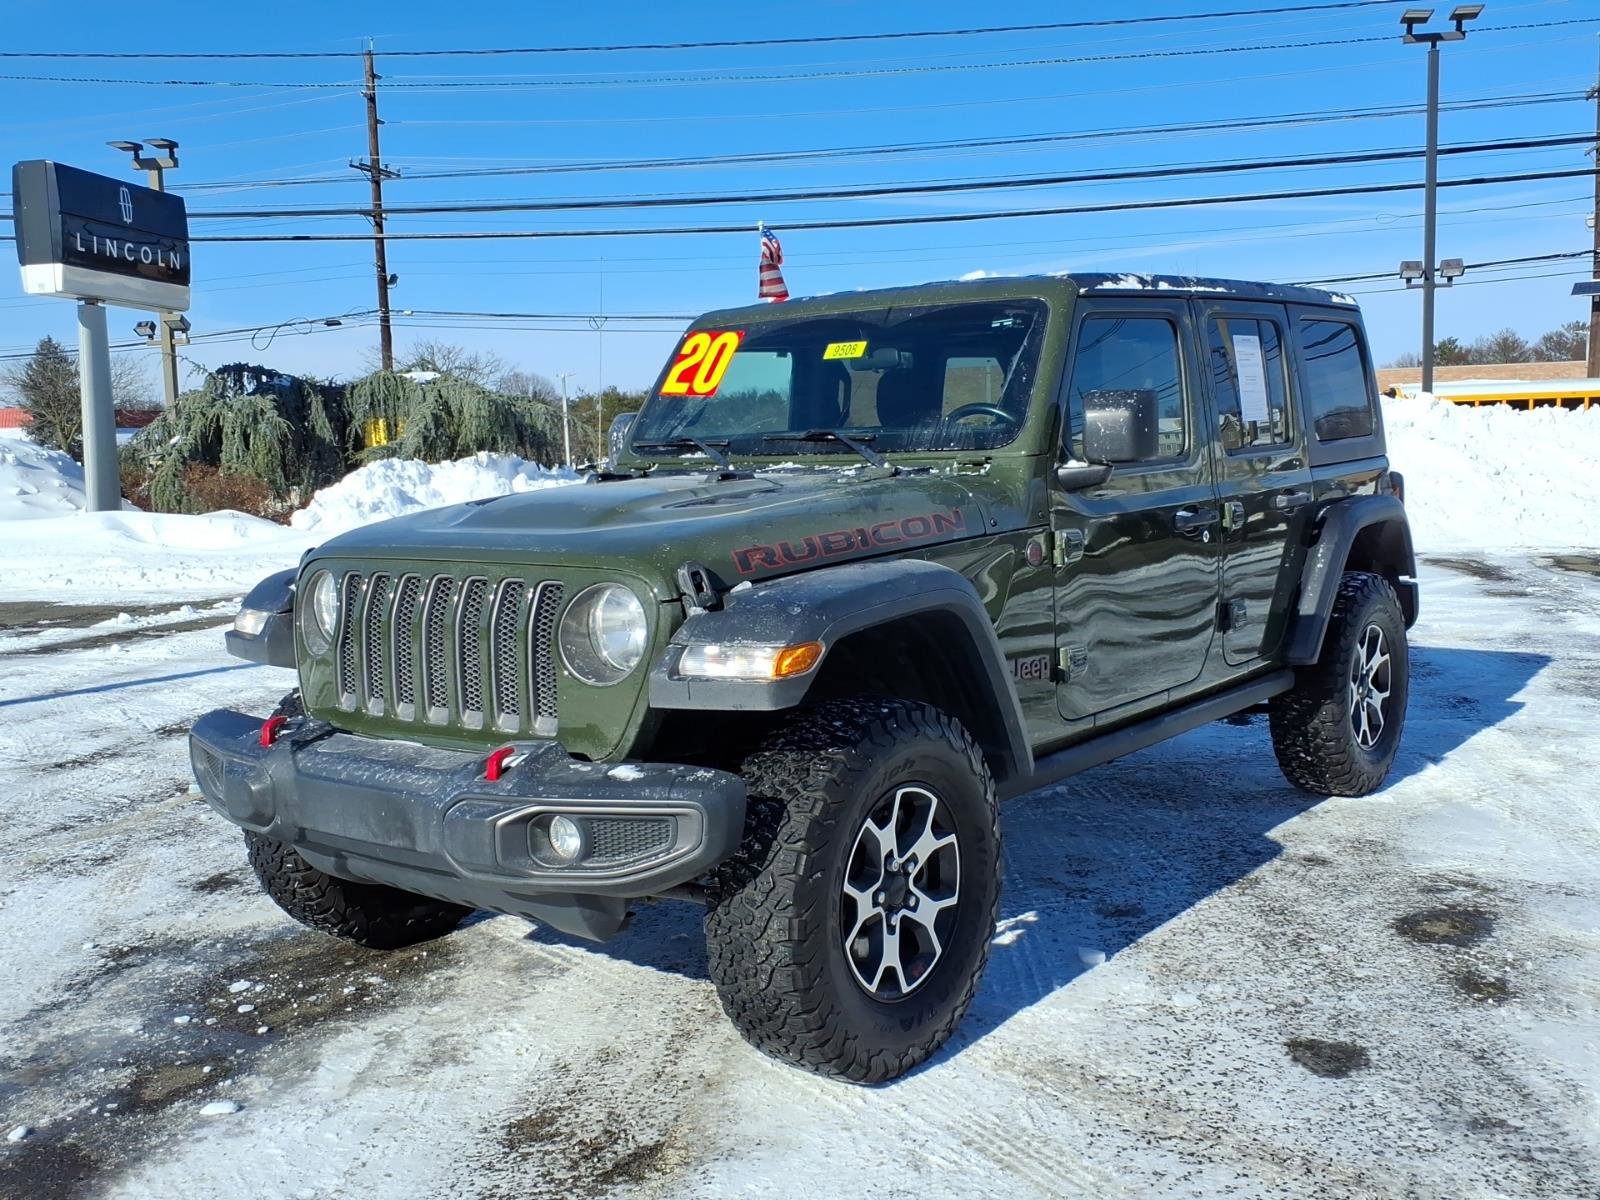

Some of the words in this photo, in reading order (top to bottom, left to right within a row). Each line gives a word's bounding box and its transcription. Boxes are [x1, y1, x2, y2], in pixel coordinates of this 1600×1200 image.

[76, 232, 181, 270] LINCOLN
[661, 331, 740, 395] 20
[832, 344, 858, 357] 9508
[731, 507, 967, 575] RUBICON
[1013, 655, 1050, 681] Jeep
